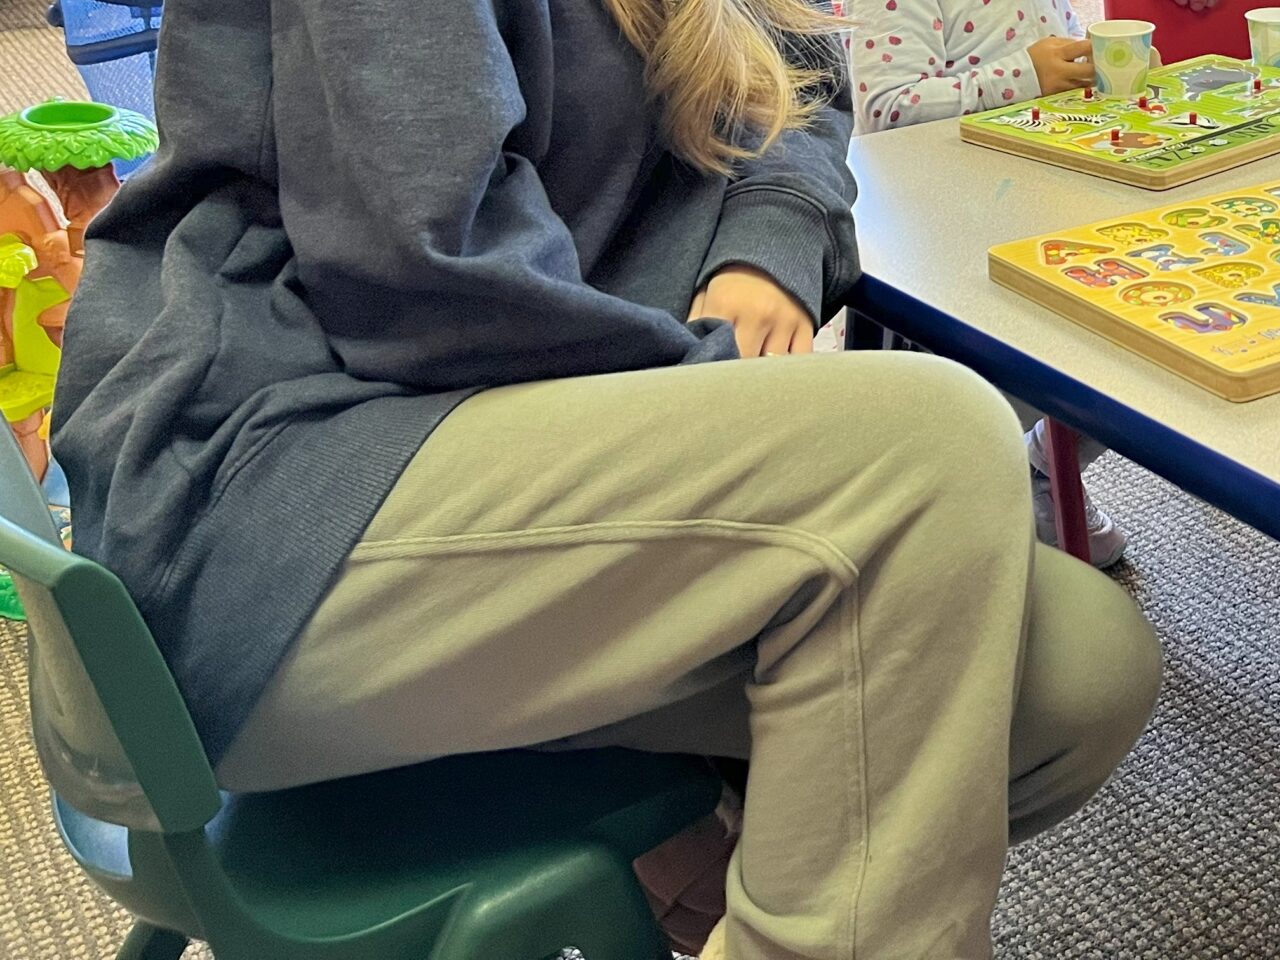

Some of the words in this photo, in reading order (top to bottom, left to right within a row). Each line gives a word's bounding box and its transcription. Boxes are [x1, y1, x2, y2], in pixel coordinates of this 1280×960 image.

[1041, 240, 1115, 265] A
[1096, 222, 1170, 246] B
[1162, 208, 1228, 229] C
[1211, 197, 1279, 218] D
[1061, 258, 1150, 288] H
[1125, 243, 1205, 271] I
[1198, 232, 1250, 256] J
[1119, 281, 1195, 307] O
[1192, 262, 1264, 289] P
[1158, 302, 1248, 334] U
